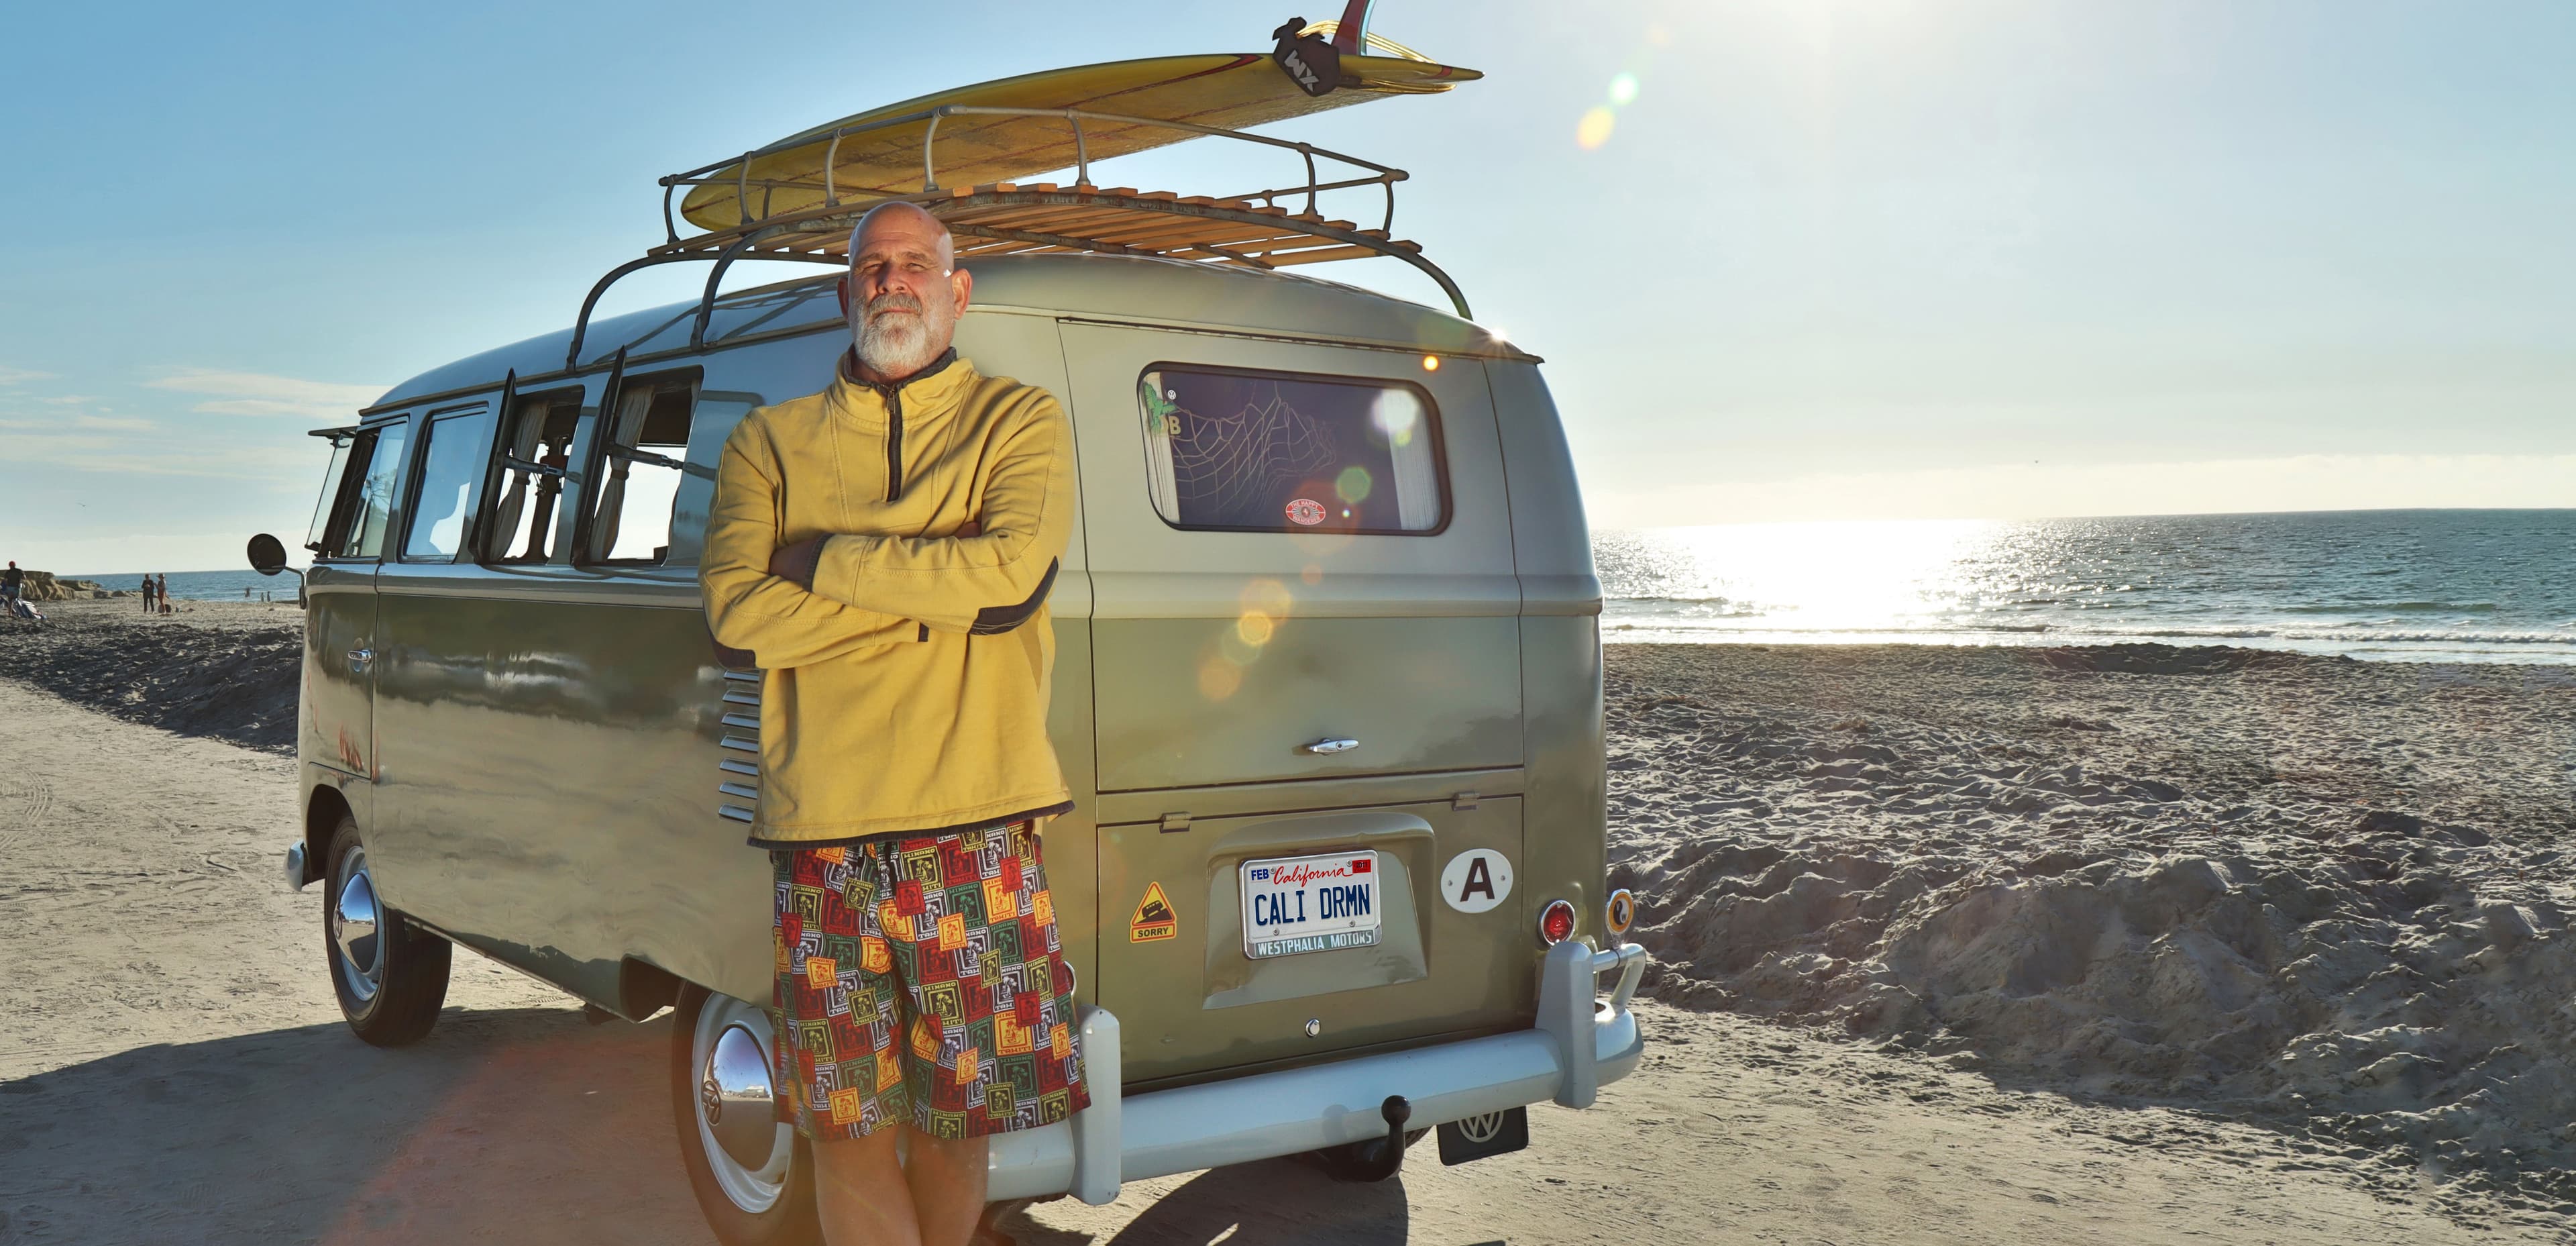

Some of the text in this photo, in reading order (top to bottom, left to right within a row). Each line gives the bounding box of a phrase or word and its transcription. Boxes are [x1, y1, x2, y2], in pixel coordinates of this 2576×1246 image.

[986, 830, 1005, 838] NANO
[904, 848, 936, 859] HINANO
[1020, 859, 1034, 867] HITI
[982, 869, 1000, 877] TAH
[1251, 863, 1352, 887] FEB California
[1460, 858, 1495, 902] A
[827, 882, 843, 891] TAH
[922, 882, 942, 891] HITI
[949, 883, 979, 894] HINANO
[924, 891, 944, 900] NANO
[1254, 884, 1371, 926] CALI DRMN
[990, 911, 1015, 922] TAHITI
[967, 929, 986, 937] NANO
[1138, 927, 1168, 937] SORRY
[1258, 930, 1372, 955] WESTPHALIA MOTORS
[1002, 965, 1022, 973] NANO
[924, 982, 957, 992] HINANO
[1039, 993, 1052, 1001] HITI
[830, 1006, 849, 1015] TAH
[875, 1038, 890, 1047] TAH
[998, 1046, 1031, 1054] TAHITI
[969, 1098, 984, 1106] TAH
